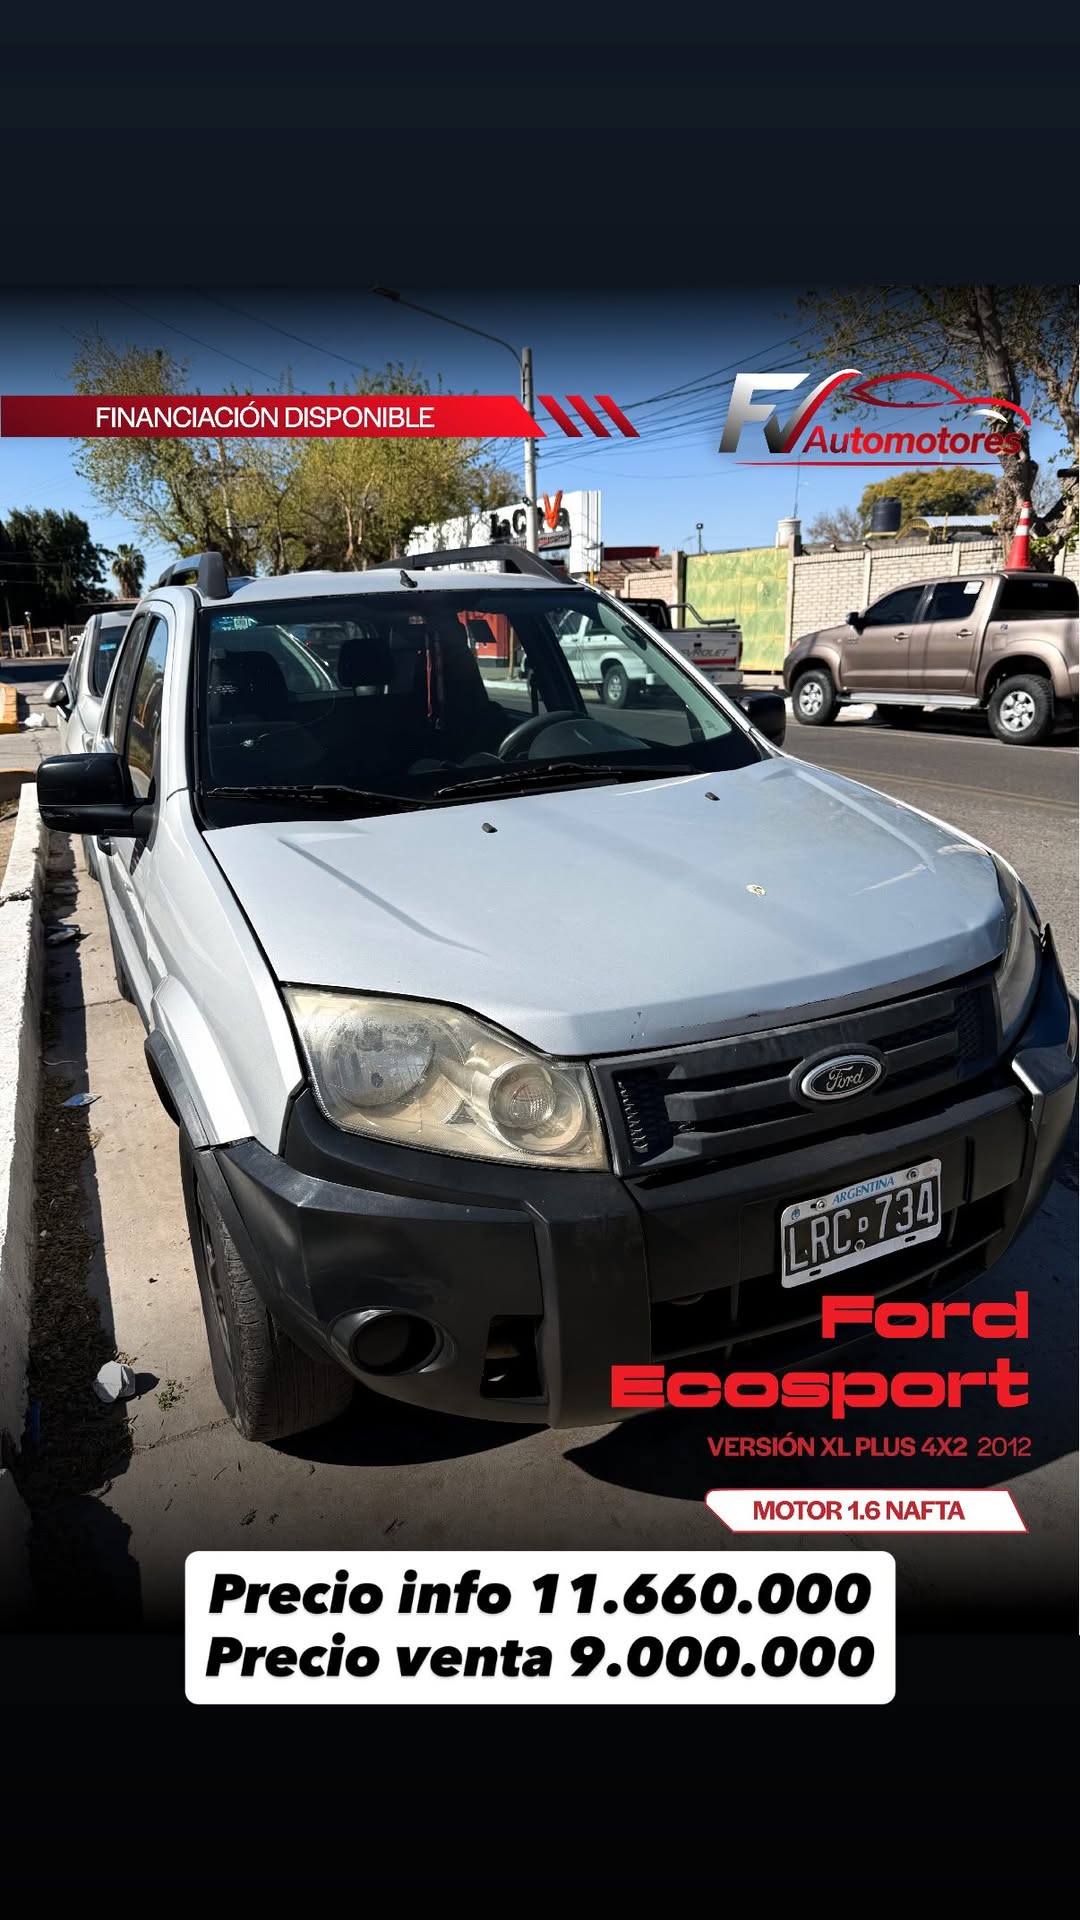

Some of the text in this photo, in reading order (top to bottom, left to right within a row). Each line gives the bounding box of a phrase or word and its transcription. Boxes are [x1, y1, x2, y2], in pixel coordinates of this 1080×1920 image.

[825, 1064, 865, 1093] Ford
[832, 1175, 896, 1206] ARGENTINA
[788, 1208, 853, 1272] LRC
[875, 1180, 936, 1240] 734
